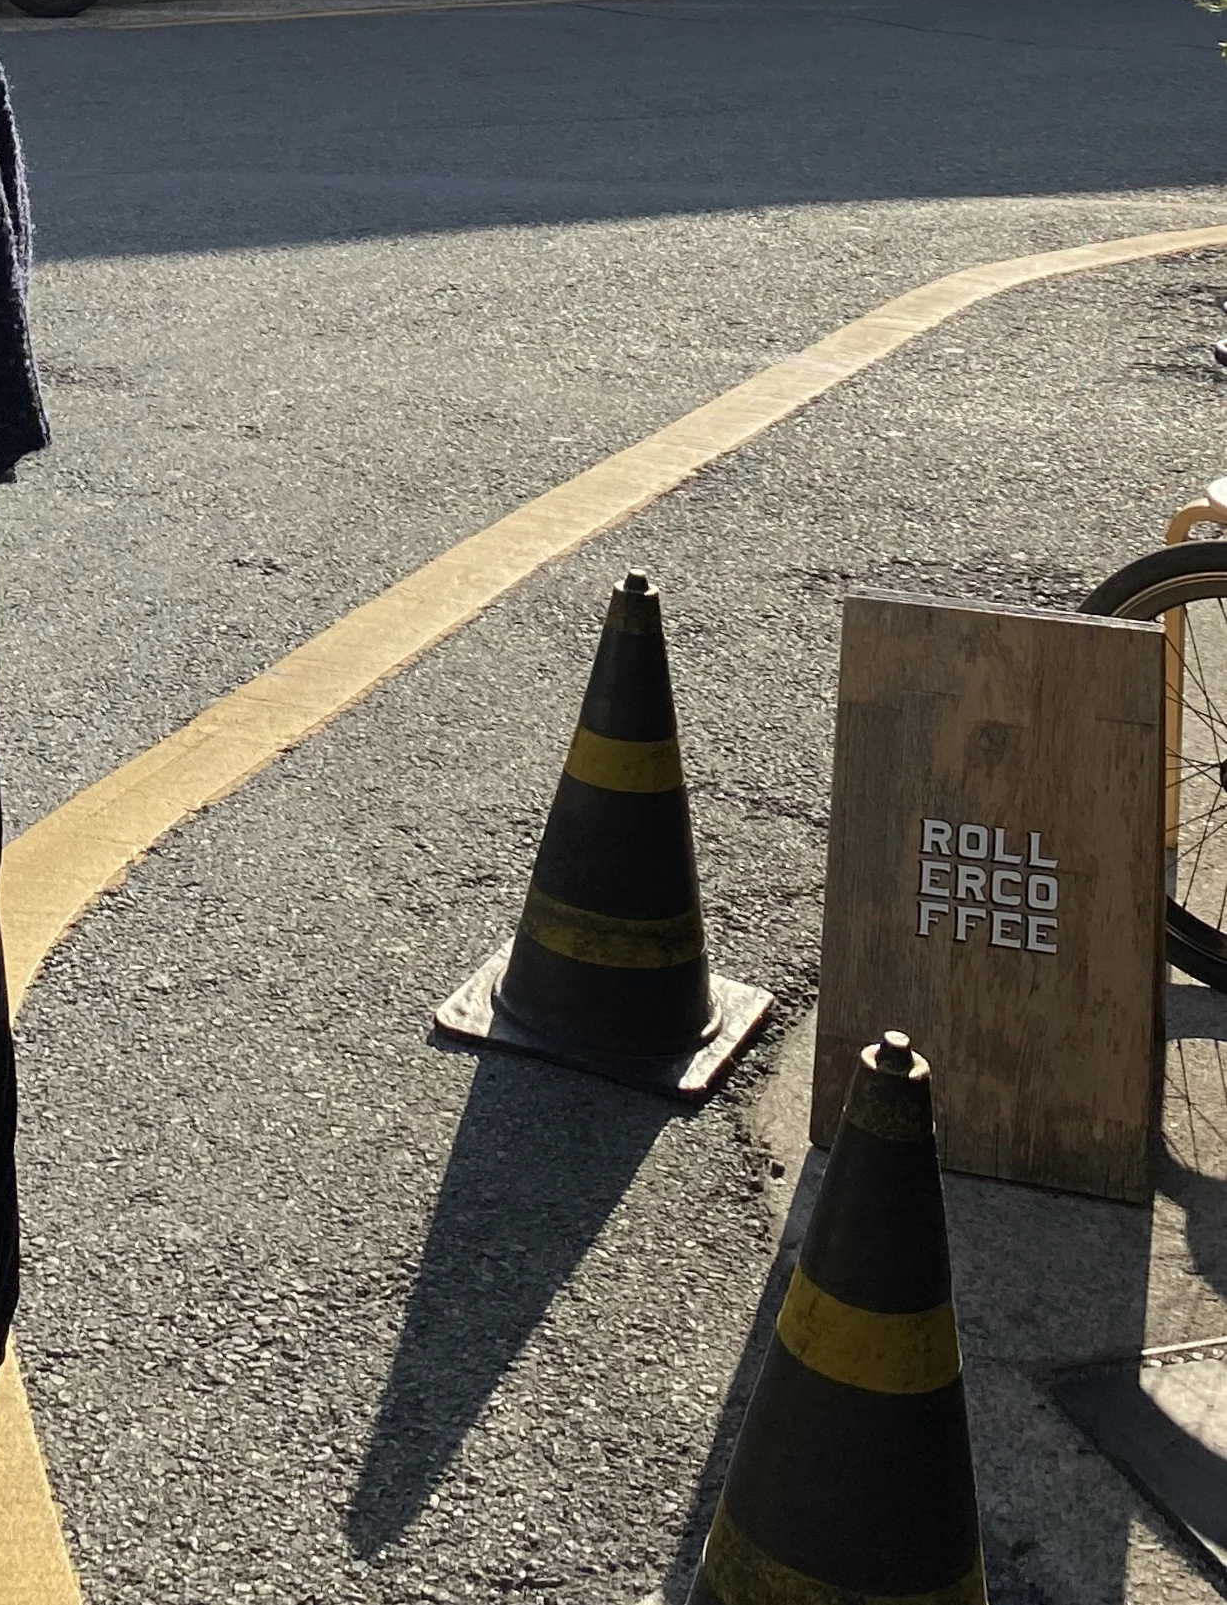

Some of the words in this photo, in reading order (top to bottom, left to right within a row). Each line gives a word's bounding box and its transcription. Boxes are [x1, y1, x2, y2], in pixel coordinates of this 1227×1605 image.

[920, 818, 1059, 869] ROLL
[918, 859, 1059, 911] ERCO
[916, 900, 1059, 954] FFEE
